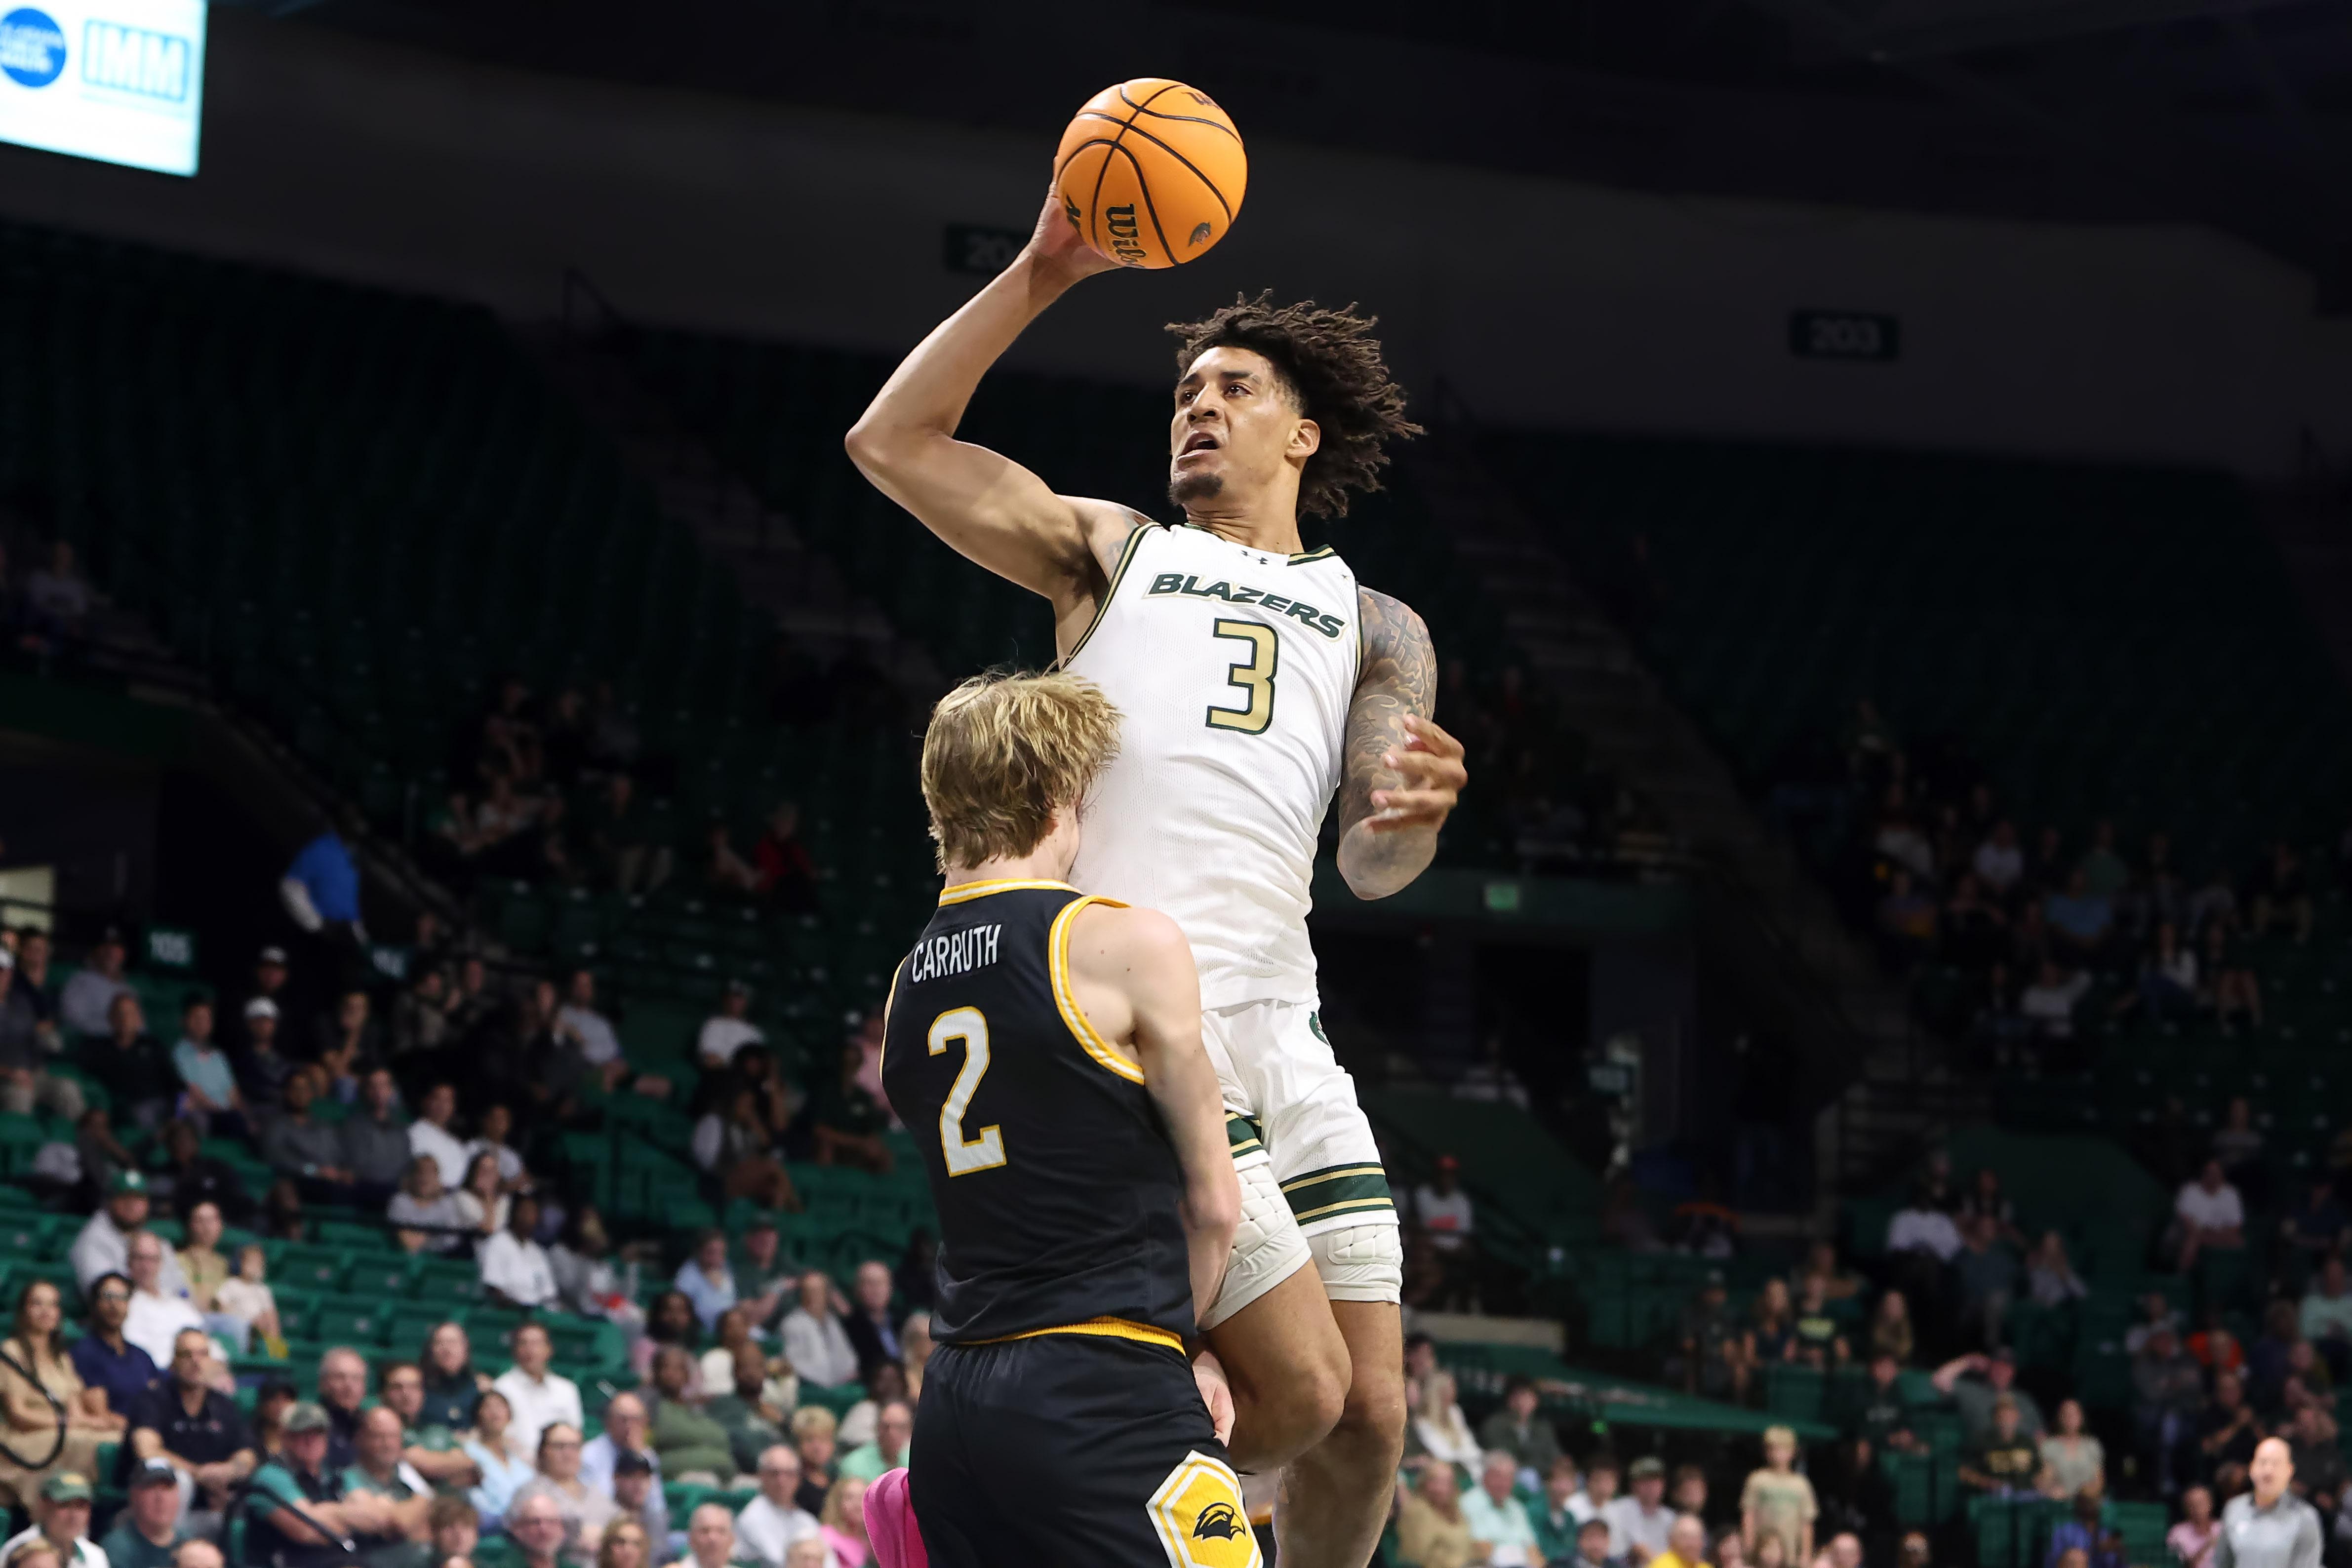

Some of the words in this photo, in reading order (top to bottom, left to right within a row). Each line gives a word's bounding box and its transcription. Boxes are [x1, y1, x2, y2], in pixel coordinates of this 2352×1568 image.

[964, 233, 1026, 270] 20
[1145, 573, 1347, 640] BLAZERS
[1205, 618, 1278, 735] 3
[912, 924, 1002, 983] CARRUTH
[927, 1005, 1008, 1178] 2
